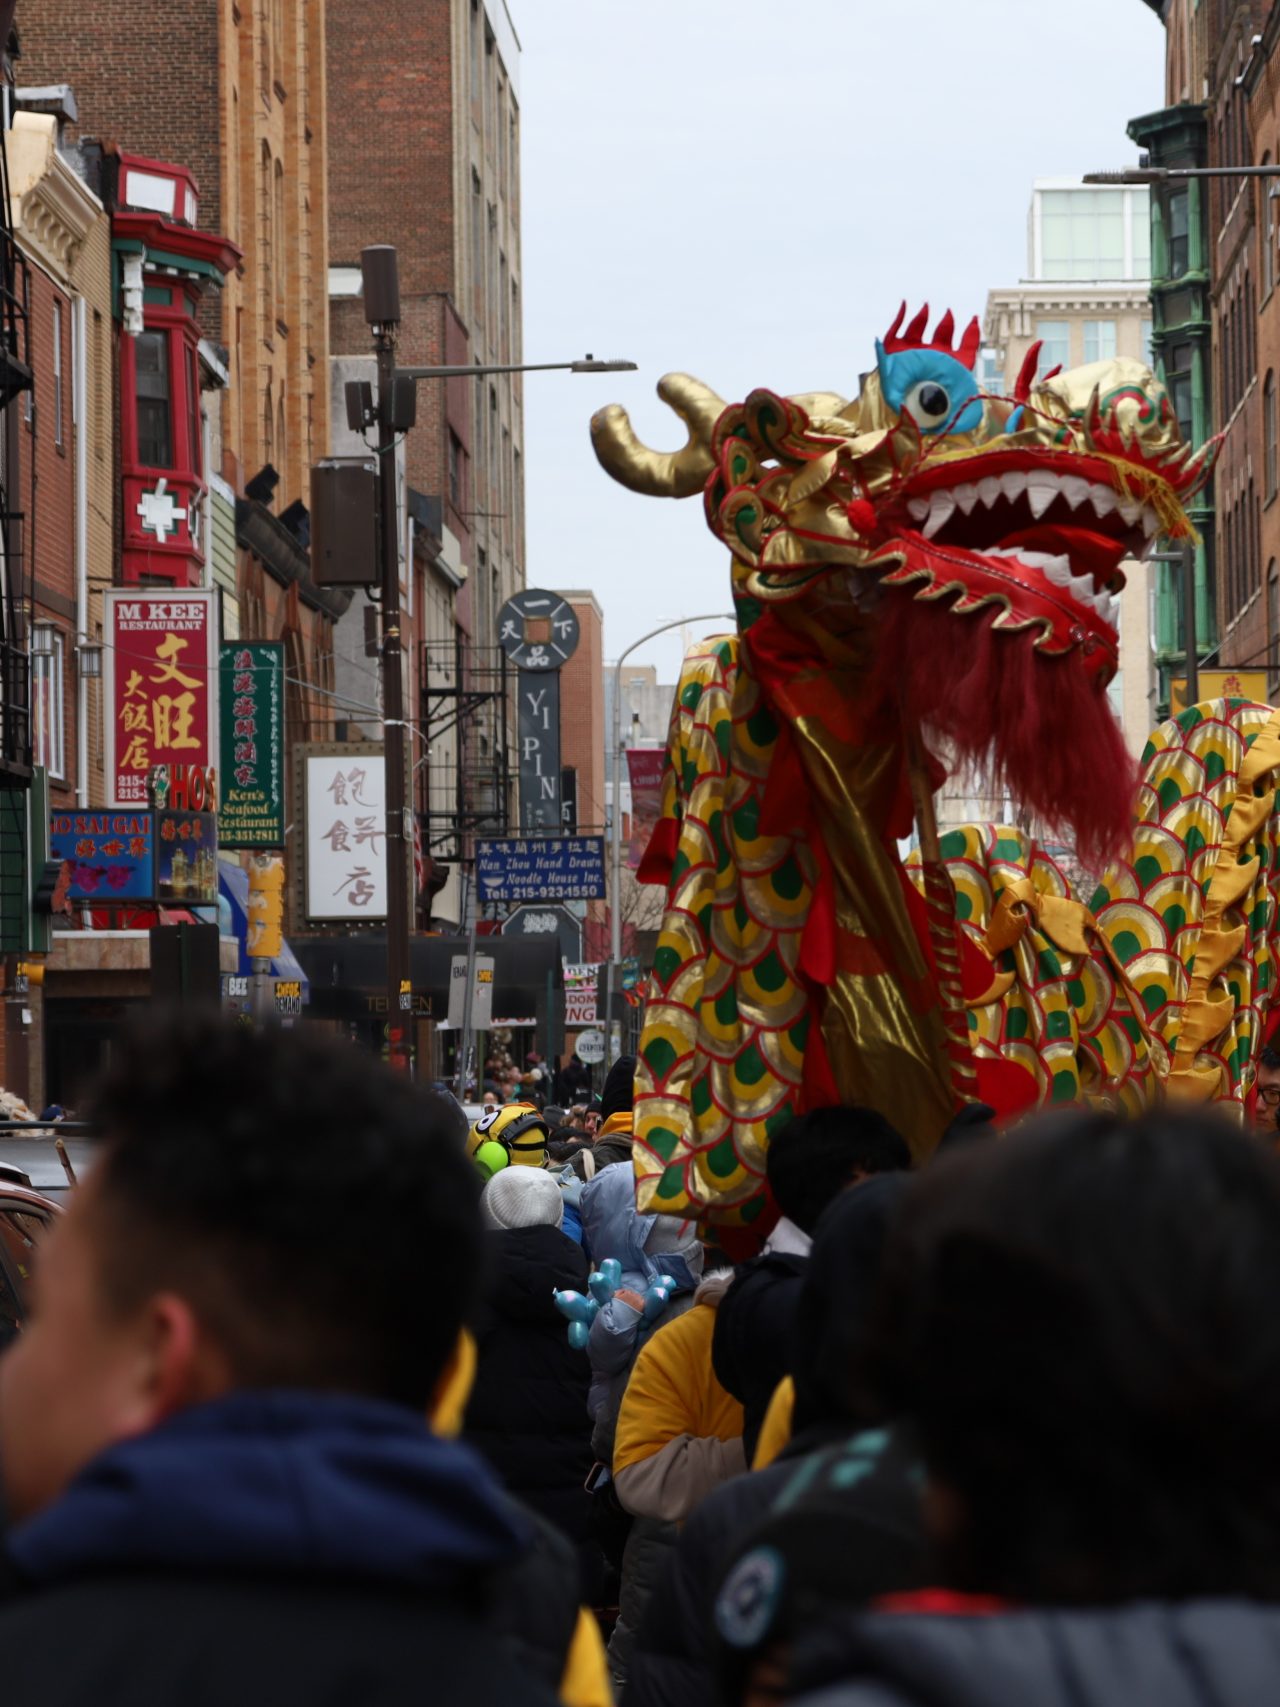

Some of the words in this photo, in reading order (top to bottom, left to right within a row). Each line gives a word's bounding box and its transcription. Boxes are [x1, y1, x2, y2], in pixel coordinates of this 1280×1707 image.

[117, 604, 141, 619] M
[148, 604, 204, 619] KEE
[119, 621, 202, 630] RESTAURANT
[149, 633, 203, 749] 文旺
[119, 670, 152, 770] 大飯店
[228, 789, 265, 800] Ken's
[223, 801, 269, 818] Seafood
[75, 816, 109, 834] SAI
[113, 816, 150, 834] GAI
[218, 830, 279, 841] 15-351-7811
[479, 859, 500, 871] Nan
[506, 858, 530, 870] Zhou
[536, 857, 563, 869] Hand
[569, 856, 601, 869] Drawn
[507, 873, 542, 885] Noodle
[548, 872, 578, 884] House
[584, 871, 603, 883] Inc.
[485, 888, 508, 899] Tel:
